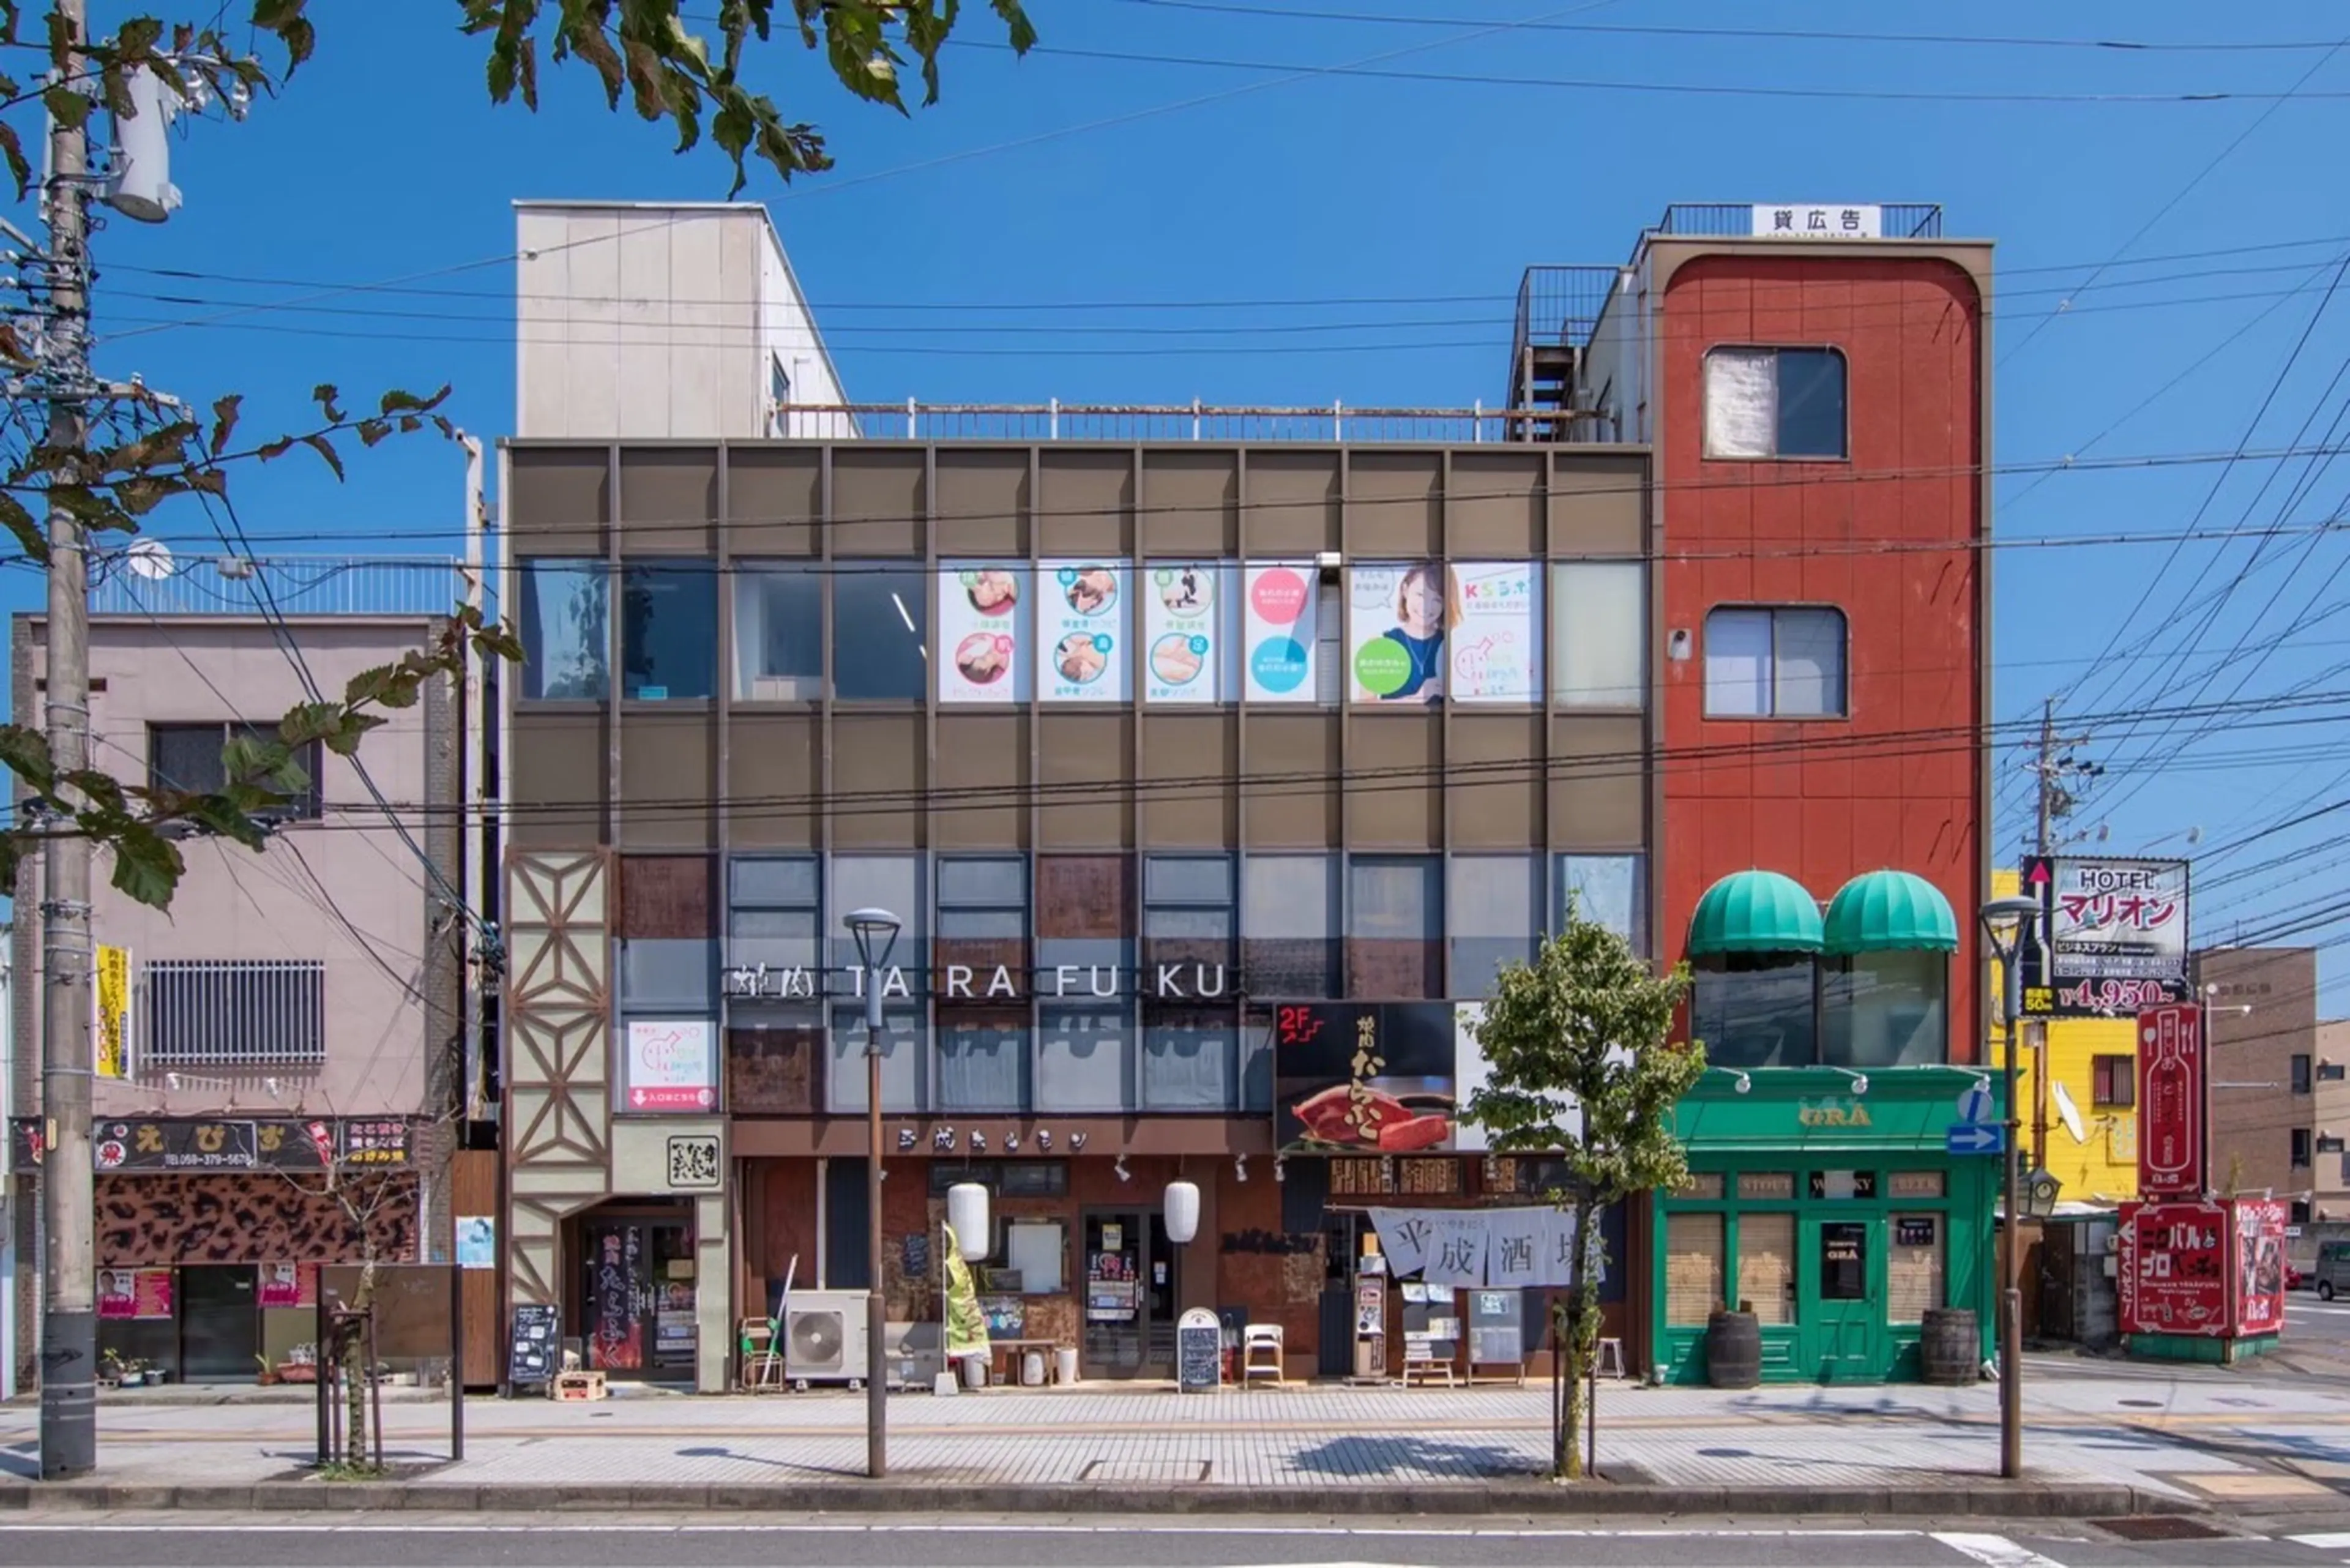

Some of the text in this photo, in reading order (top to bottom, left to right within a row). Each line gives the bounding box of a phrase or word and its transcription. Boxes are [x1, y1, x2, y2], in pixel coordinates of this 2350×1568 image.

[1774, 209, 1860, 231] 貸広告
[2081, 871, 2154, 889] HOTEL
[2061, 895, 2175, 926] マリオン
[1280, 1007, 1310, 1029] 2F
[135, 1124, 286, 1152] えびす
[1812, 1177, 1873, 1191] WKY
